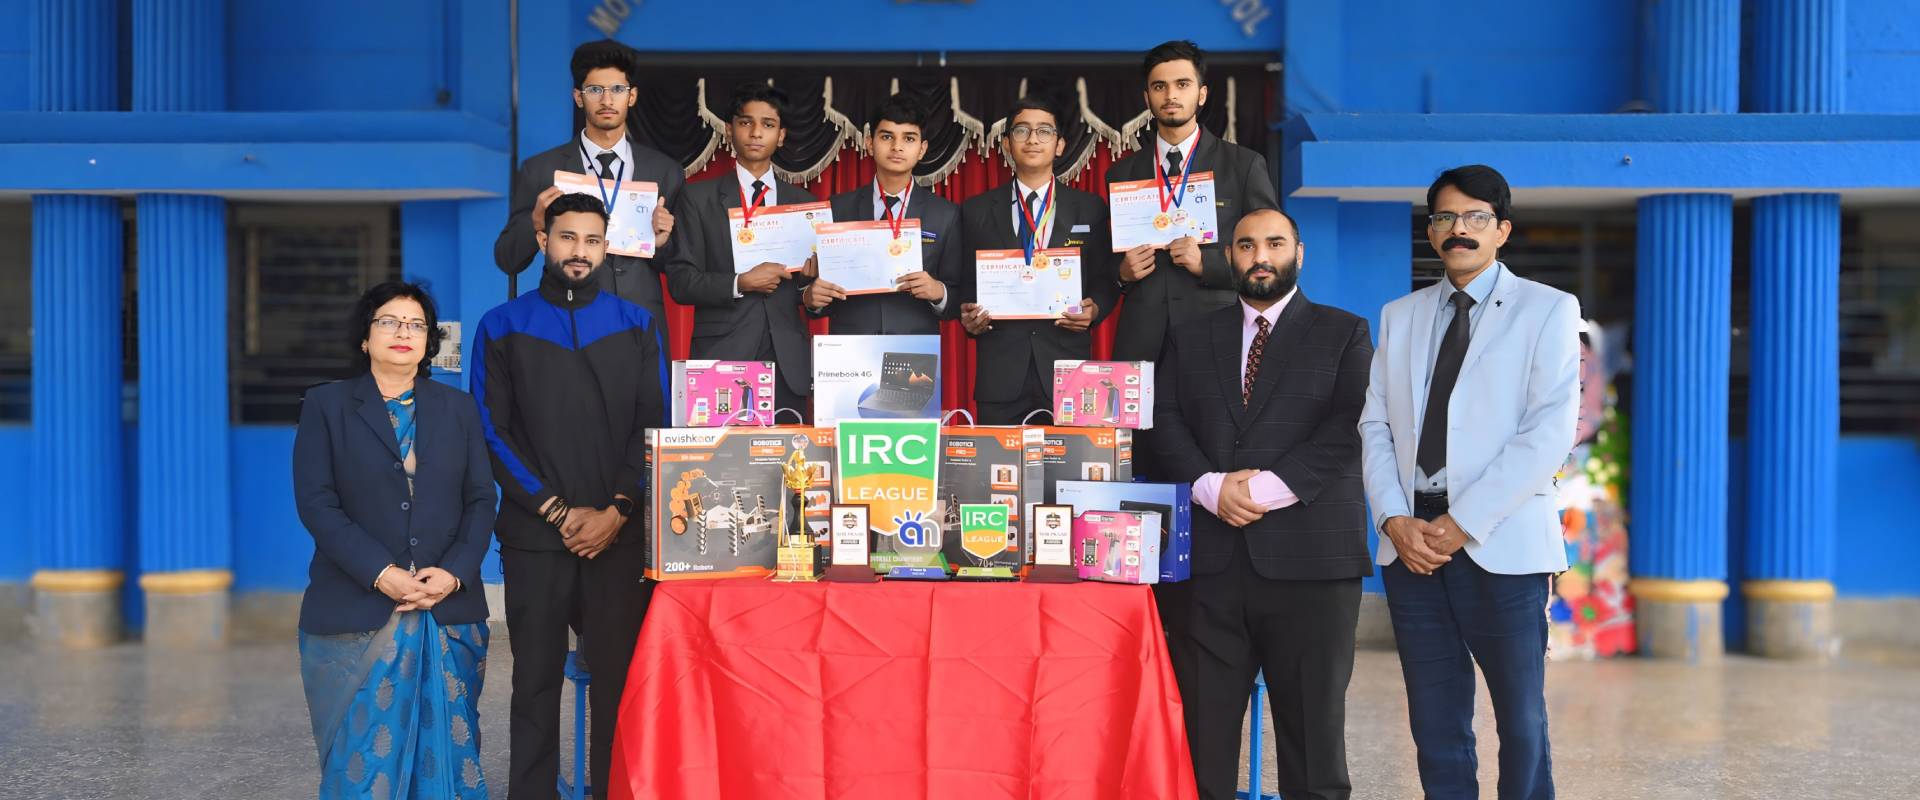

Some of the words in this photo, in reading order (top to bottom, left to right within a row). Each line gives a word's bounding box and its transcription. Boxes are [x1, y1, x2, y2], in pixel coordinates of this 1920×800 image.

[818, 370, 859, 378] Primebook
[861, 370, 872, 378] 4G
[818, 435, 833, 444] 12+
[1006, 439, 1020, 447] 12+
[1097, 436, 1113, 445] 12+
[848, 434, 928, 465] IRC
[848, 487, 928, 501] LEAGUE
[965, 511, 1004, 527] IRC
[665, 562, 691, 572] 200+
